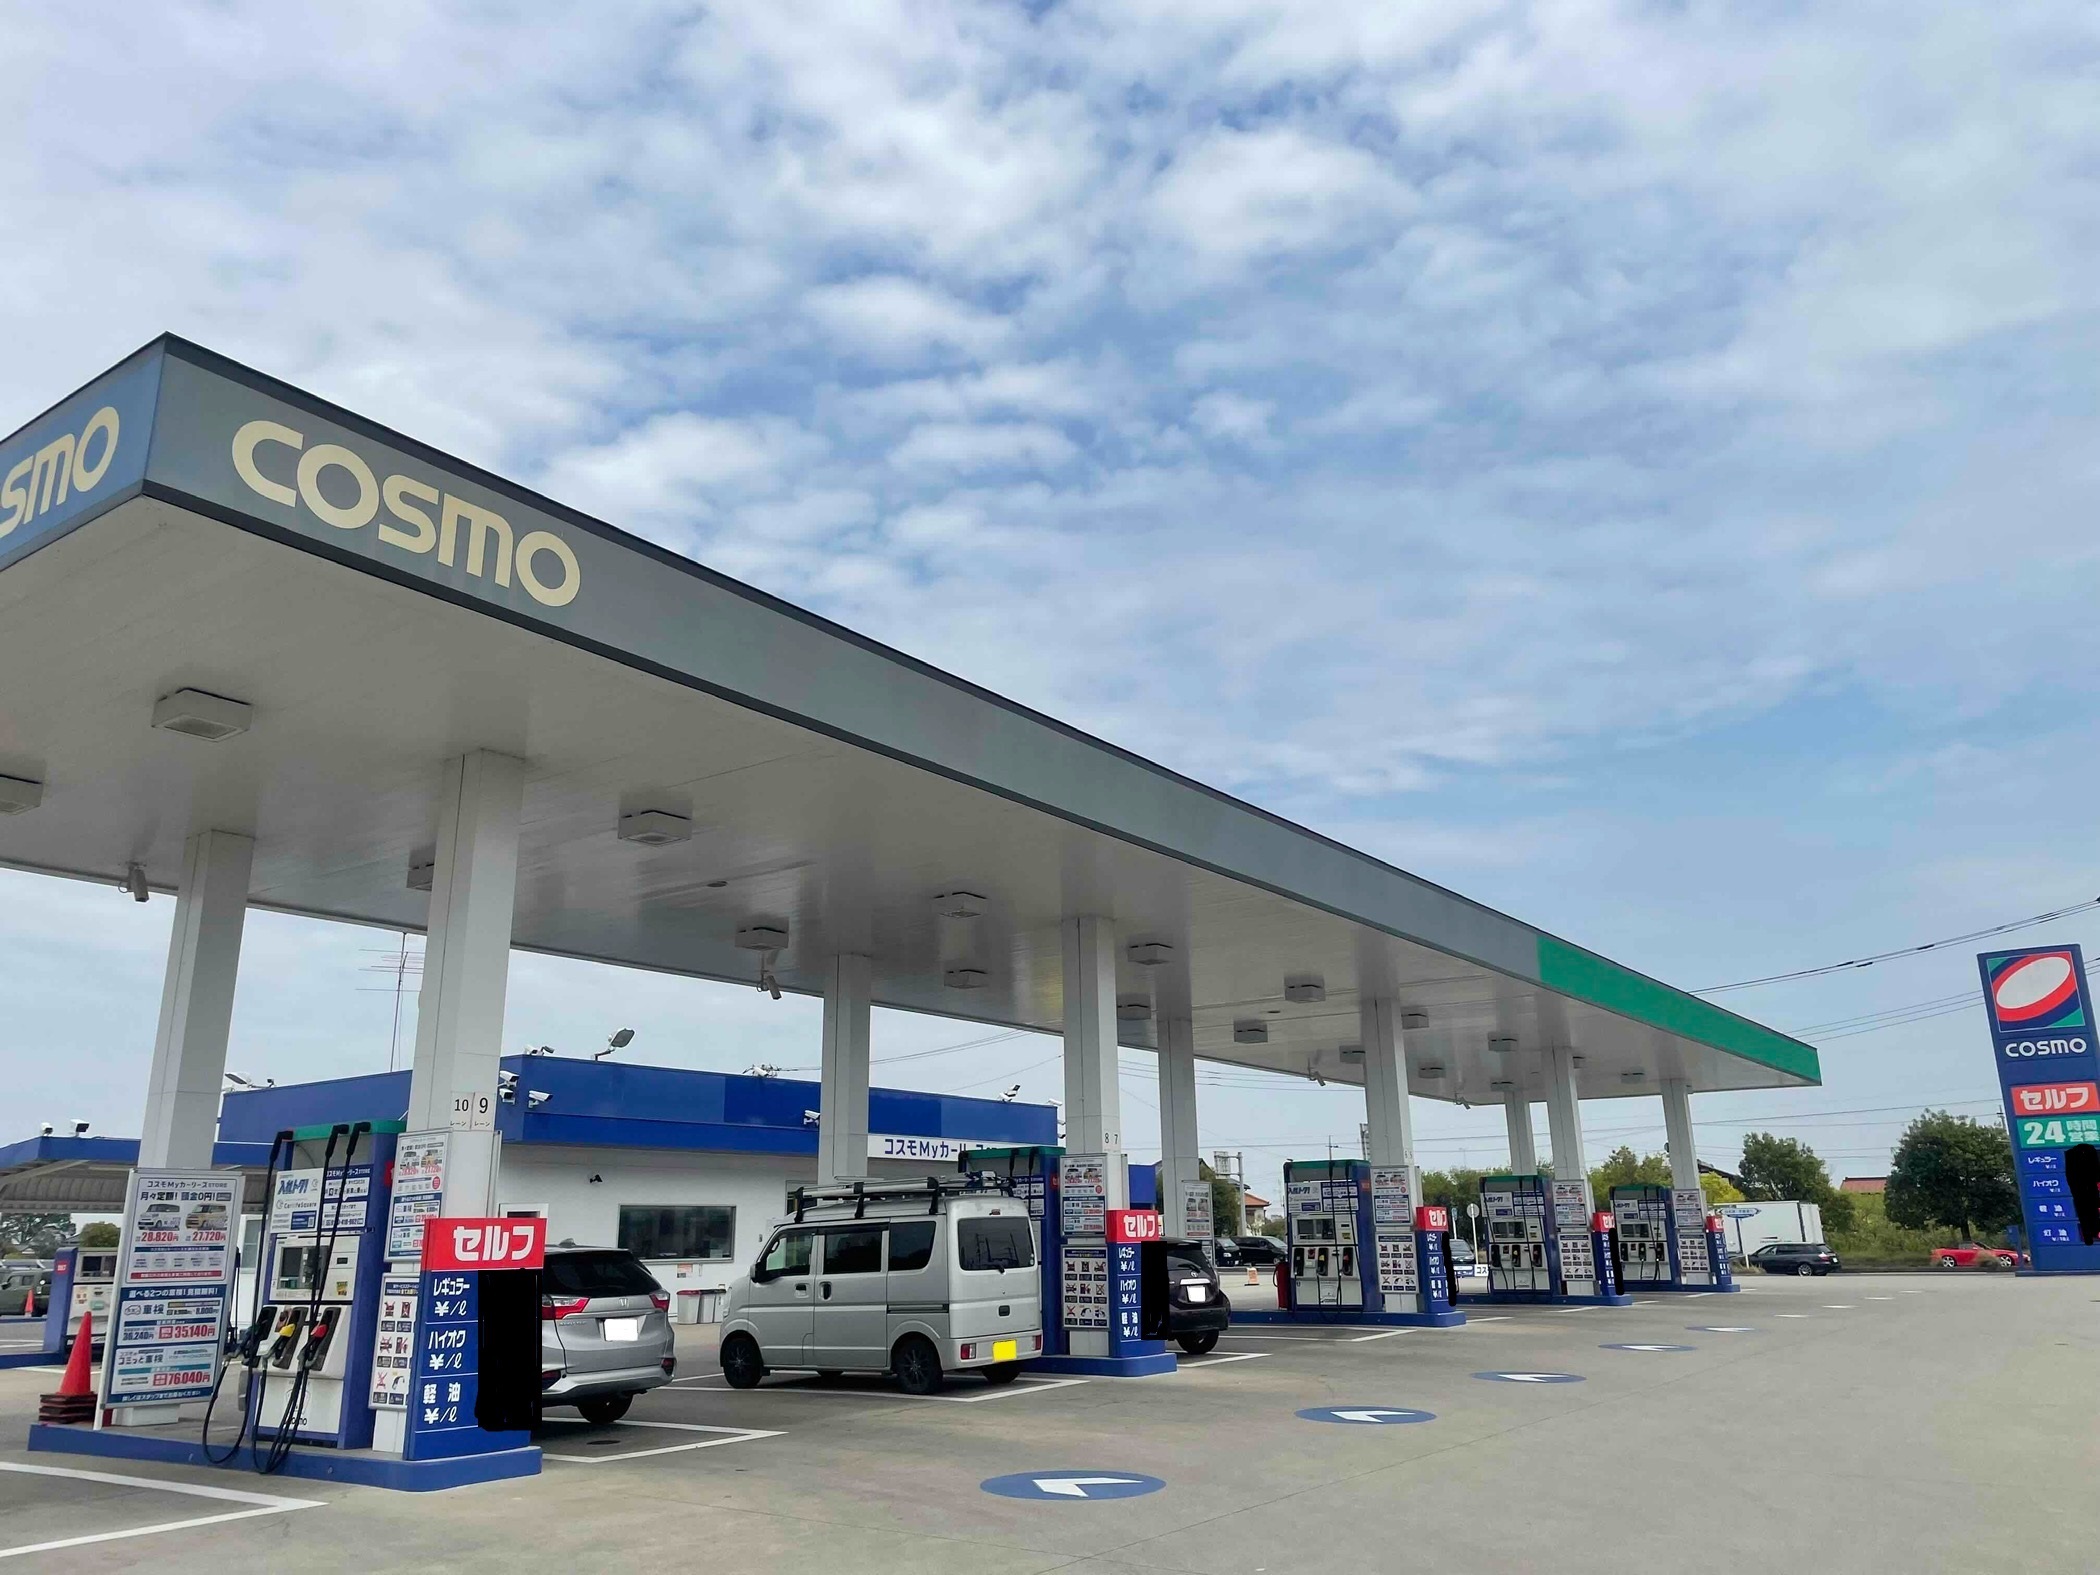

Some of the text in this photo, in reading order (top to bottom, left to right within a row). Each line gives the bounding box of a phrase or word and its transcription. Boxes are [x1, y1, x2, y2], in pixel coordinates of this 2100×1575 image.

[231, 420, 581, 607] COSMO
[2005, 1038, 2087, 1058] COSMO
[454, 1097, 488, 1114] 10 9
[2020, 1086, 2089, 1111] セルフ
[1104, 1132, 1119, 1145] 8 7
[2023, 1121, 2066, 1145] 24
[1123, 1214, 1156, 1238] セルフ
[453, 1225, 535, 1262] セルフ
[433, 1277, 471, 1296] レギュラー
[428, 1329, 467, 1350] ハイオク
[423, 1381, 461, 1405] 軽油
